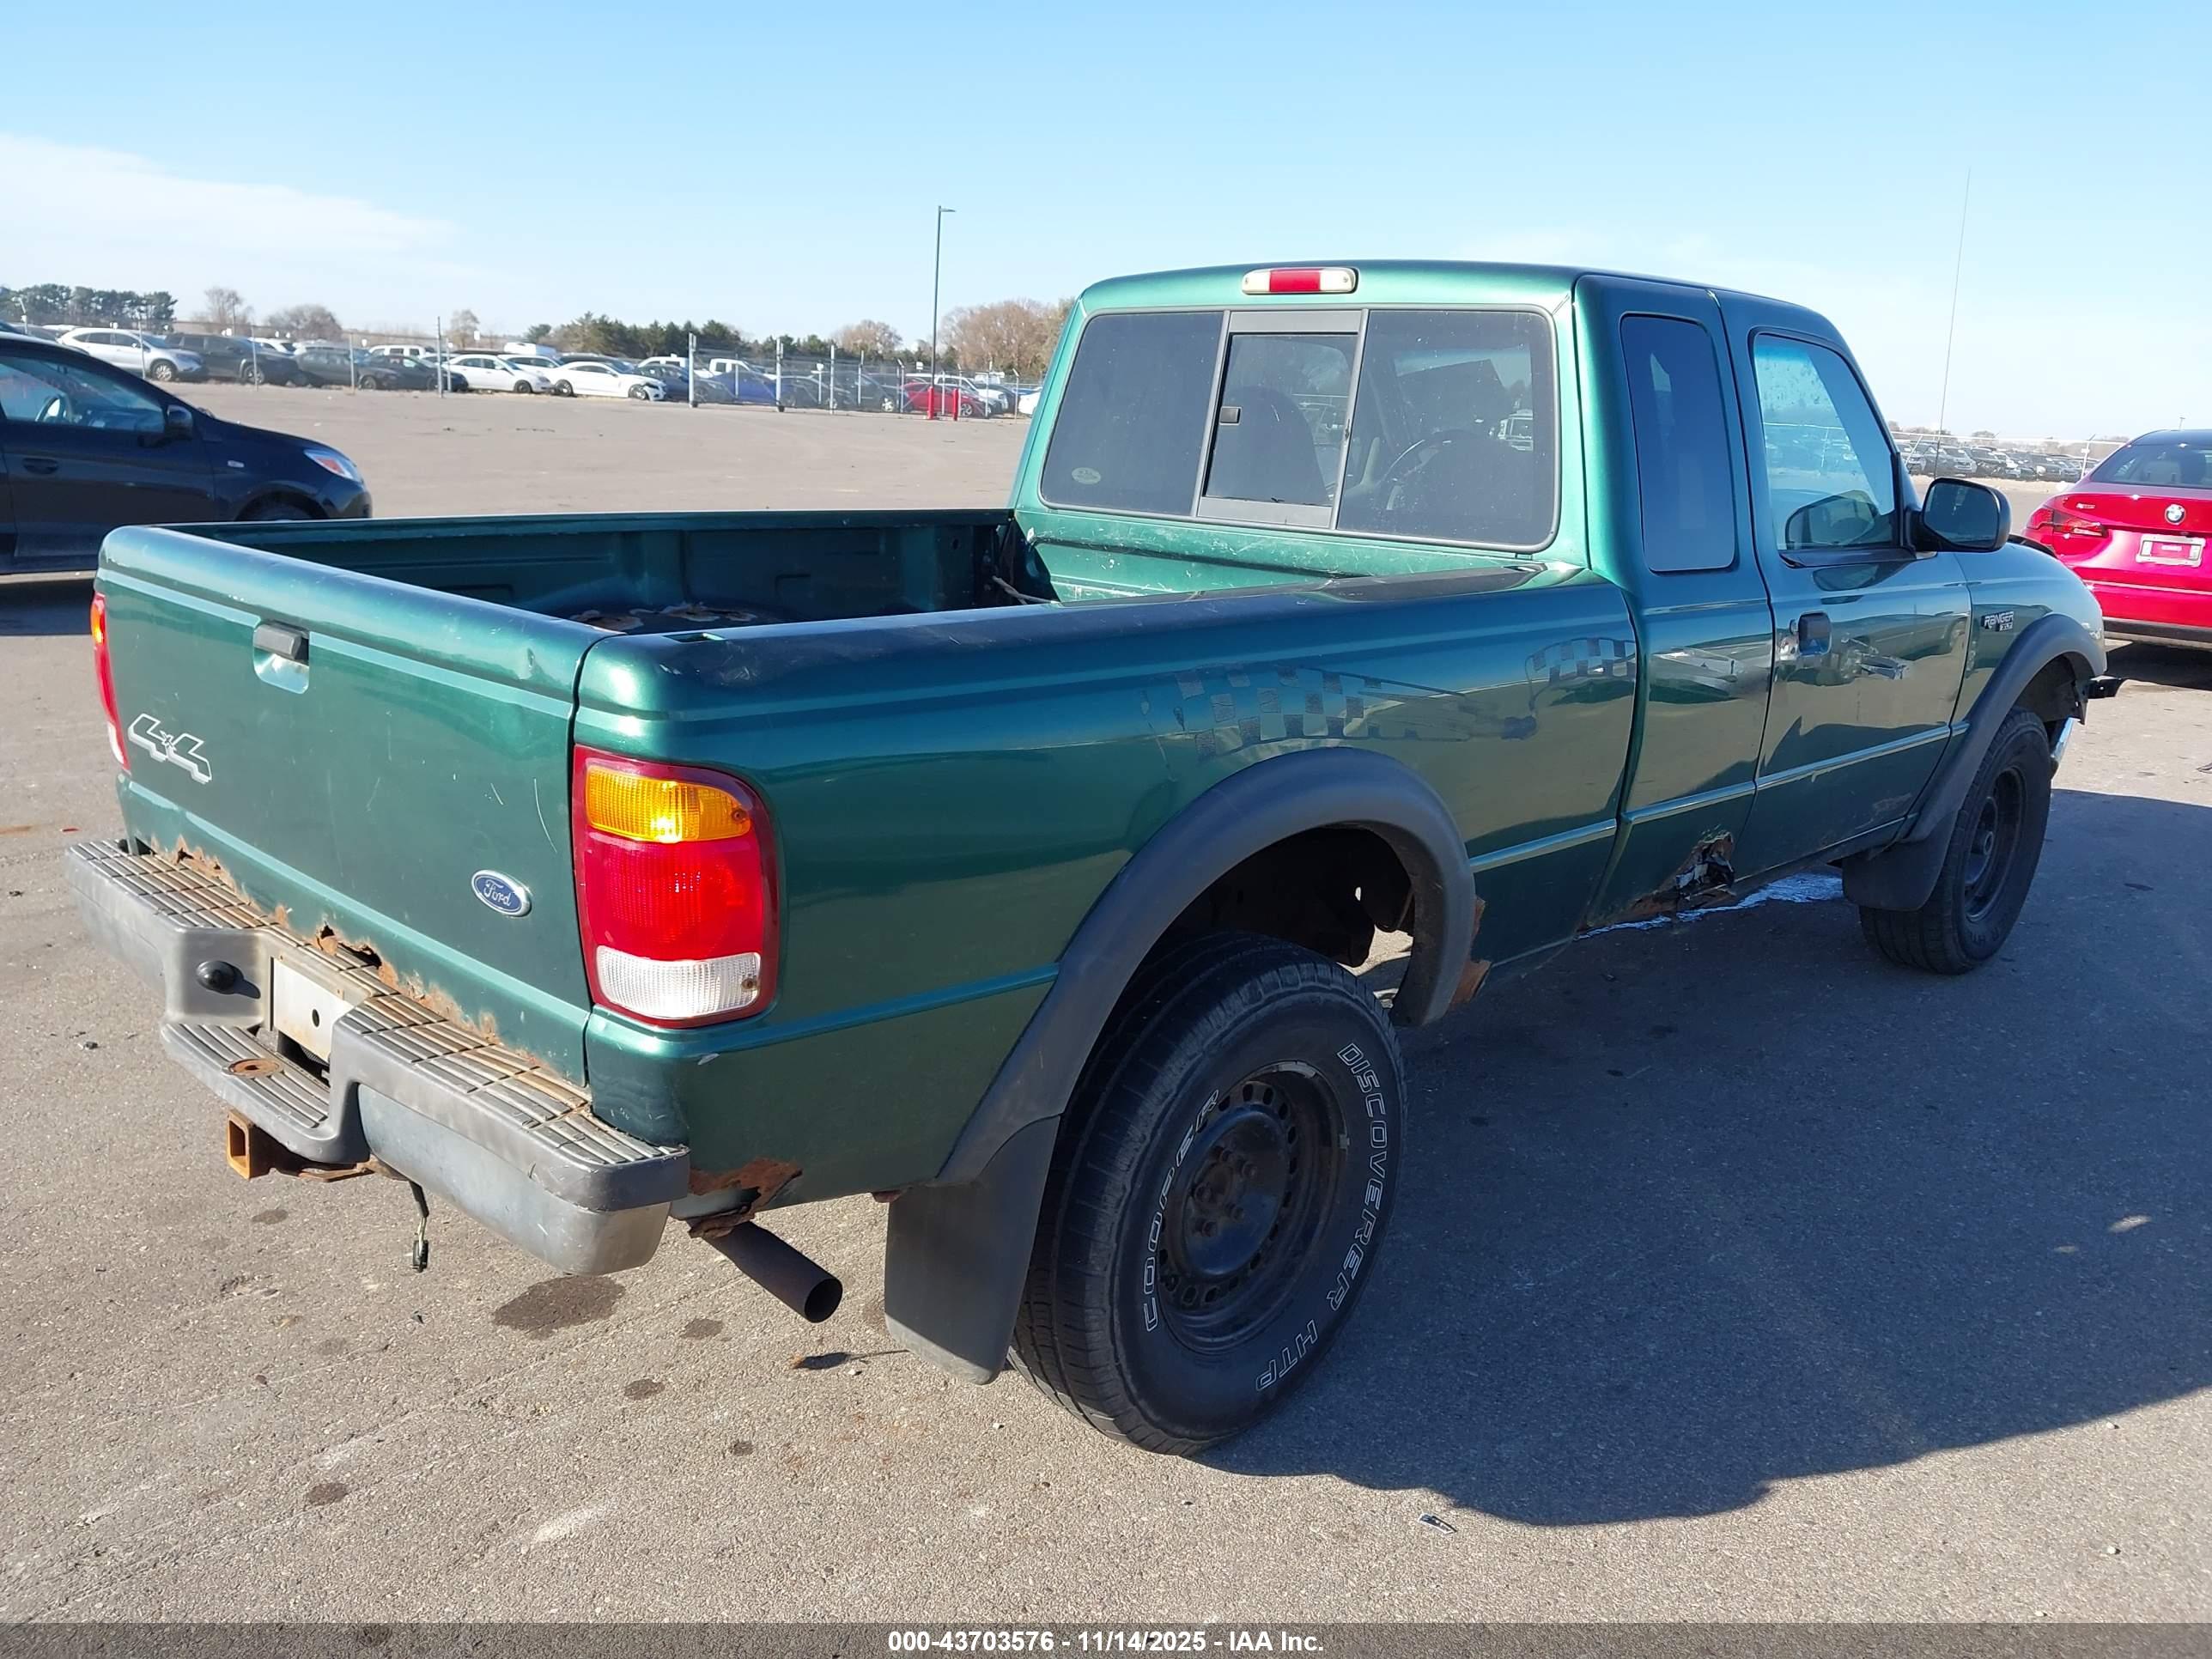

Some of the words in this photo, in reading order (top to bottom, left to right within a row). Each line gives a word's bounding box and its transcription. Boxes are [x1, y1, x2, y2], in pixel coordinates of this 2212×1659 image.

[1984, 611, 2014, 629] RANGER
[483, 878, 512, 907] Ford
[1143, 1089, 1220, 1332] COOPER
[1327, 1042, 1388, 1311] DISCOVERER
[1255, 1319, 1319, 1391] HTP
